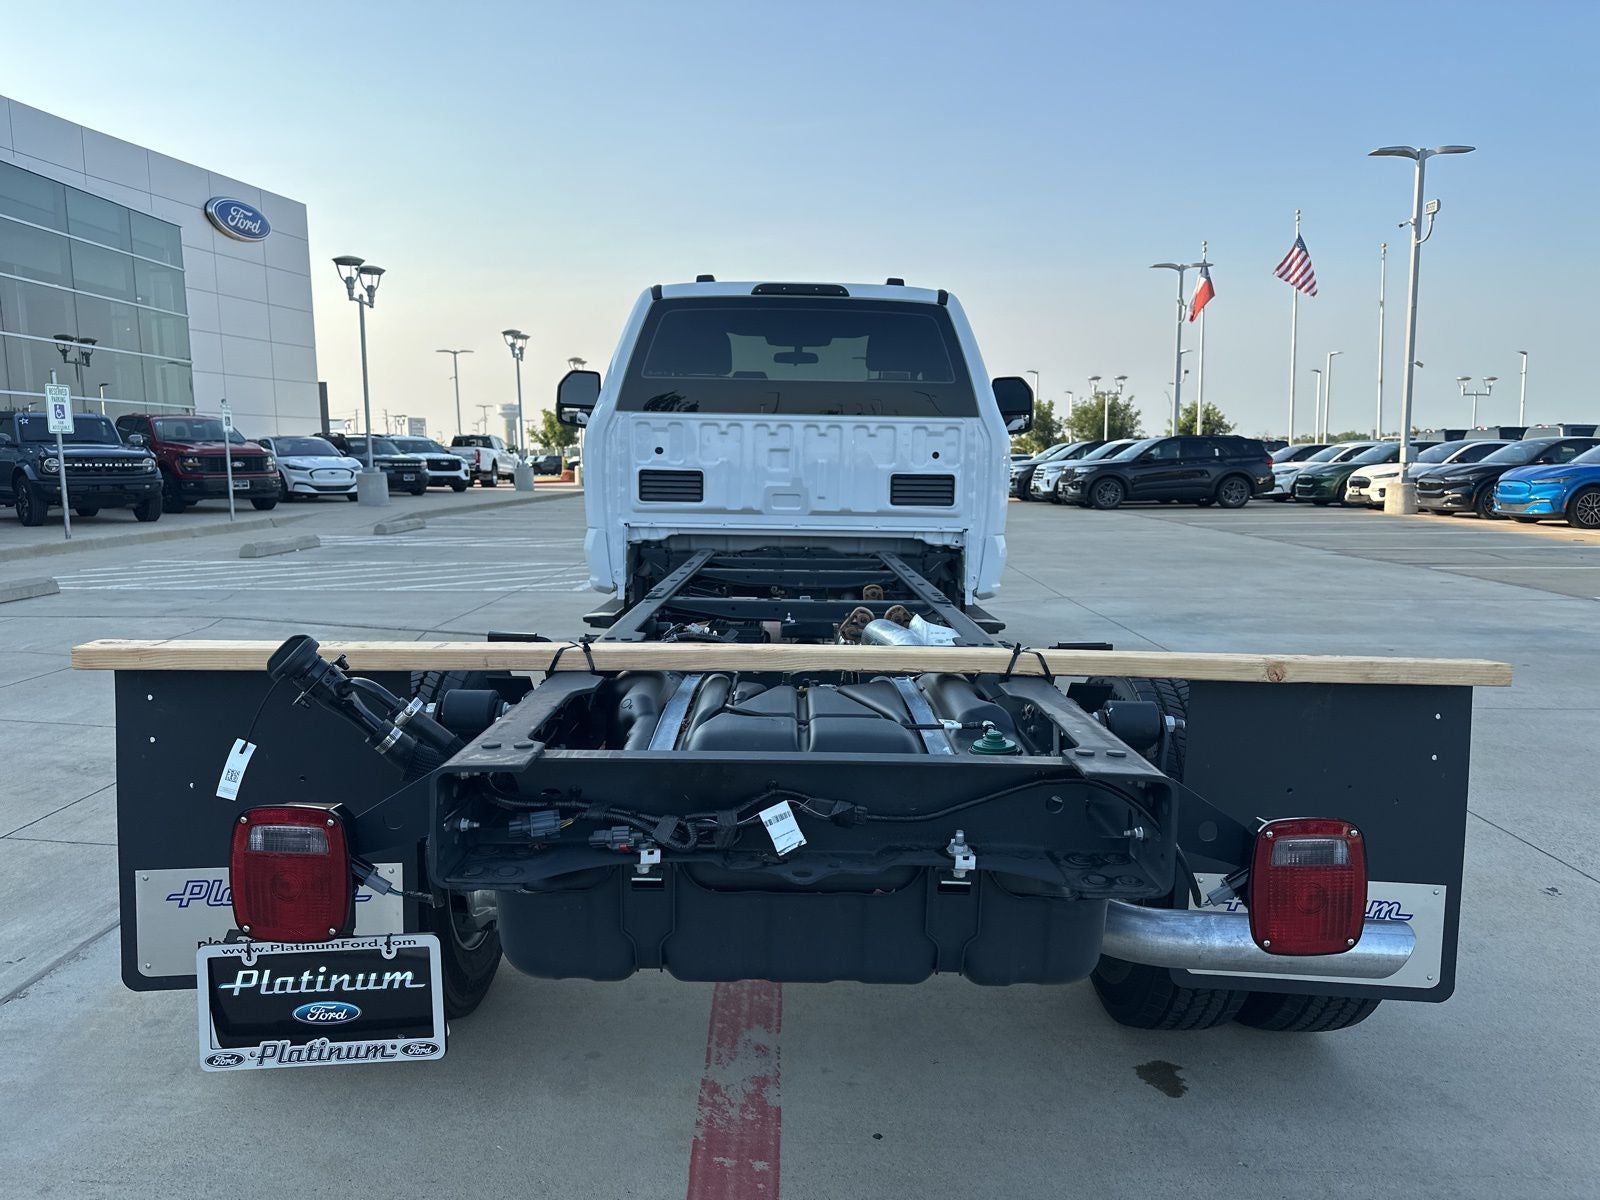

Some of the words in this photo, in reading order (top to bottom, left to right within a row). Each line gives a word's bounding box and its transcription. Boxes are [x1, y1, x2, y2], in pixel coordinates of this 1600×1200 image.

[228, 206, 261, 234] Ford
[218, 966, 426, 996] Platinum
[306, 1006, 348, 1022] Ford
[211, 1053, 239, 1066] Ford
[249, 1039, 398, 1067] Platinum
[407, 1042, 433, 1056] Ford
